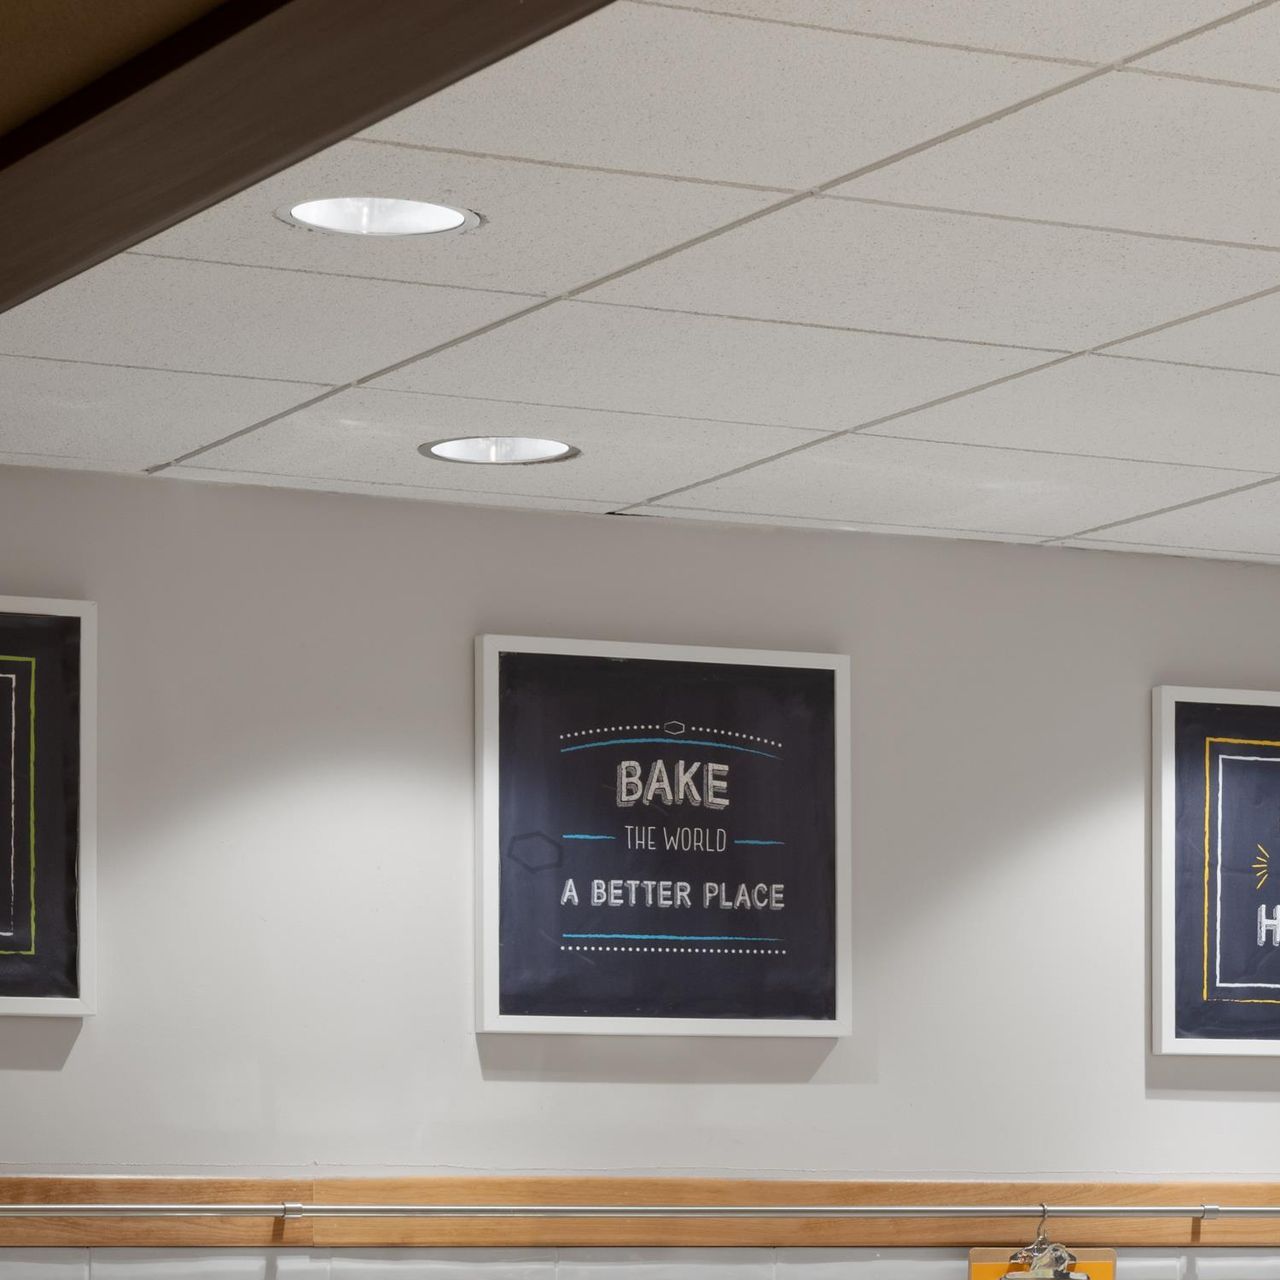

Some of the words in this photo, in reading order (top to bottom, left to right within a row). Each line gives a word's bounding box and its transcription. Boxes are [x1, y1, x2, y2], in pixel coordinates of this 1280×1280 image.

[617, 758, 730, 809] BAKE
[625, 825, 656, 851] THE
[663, 826, 728, 852] WORLD
[560, 878, 580, 906] A
[590, 879, 691, 908] BETTER
[704, 882, 785, 910] PLACE
